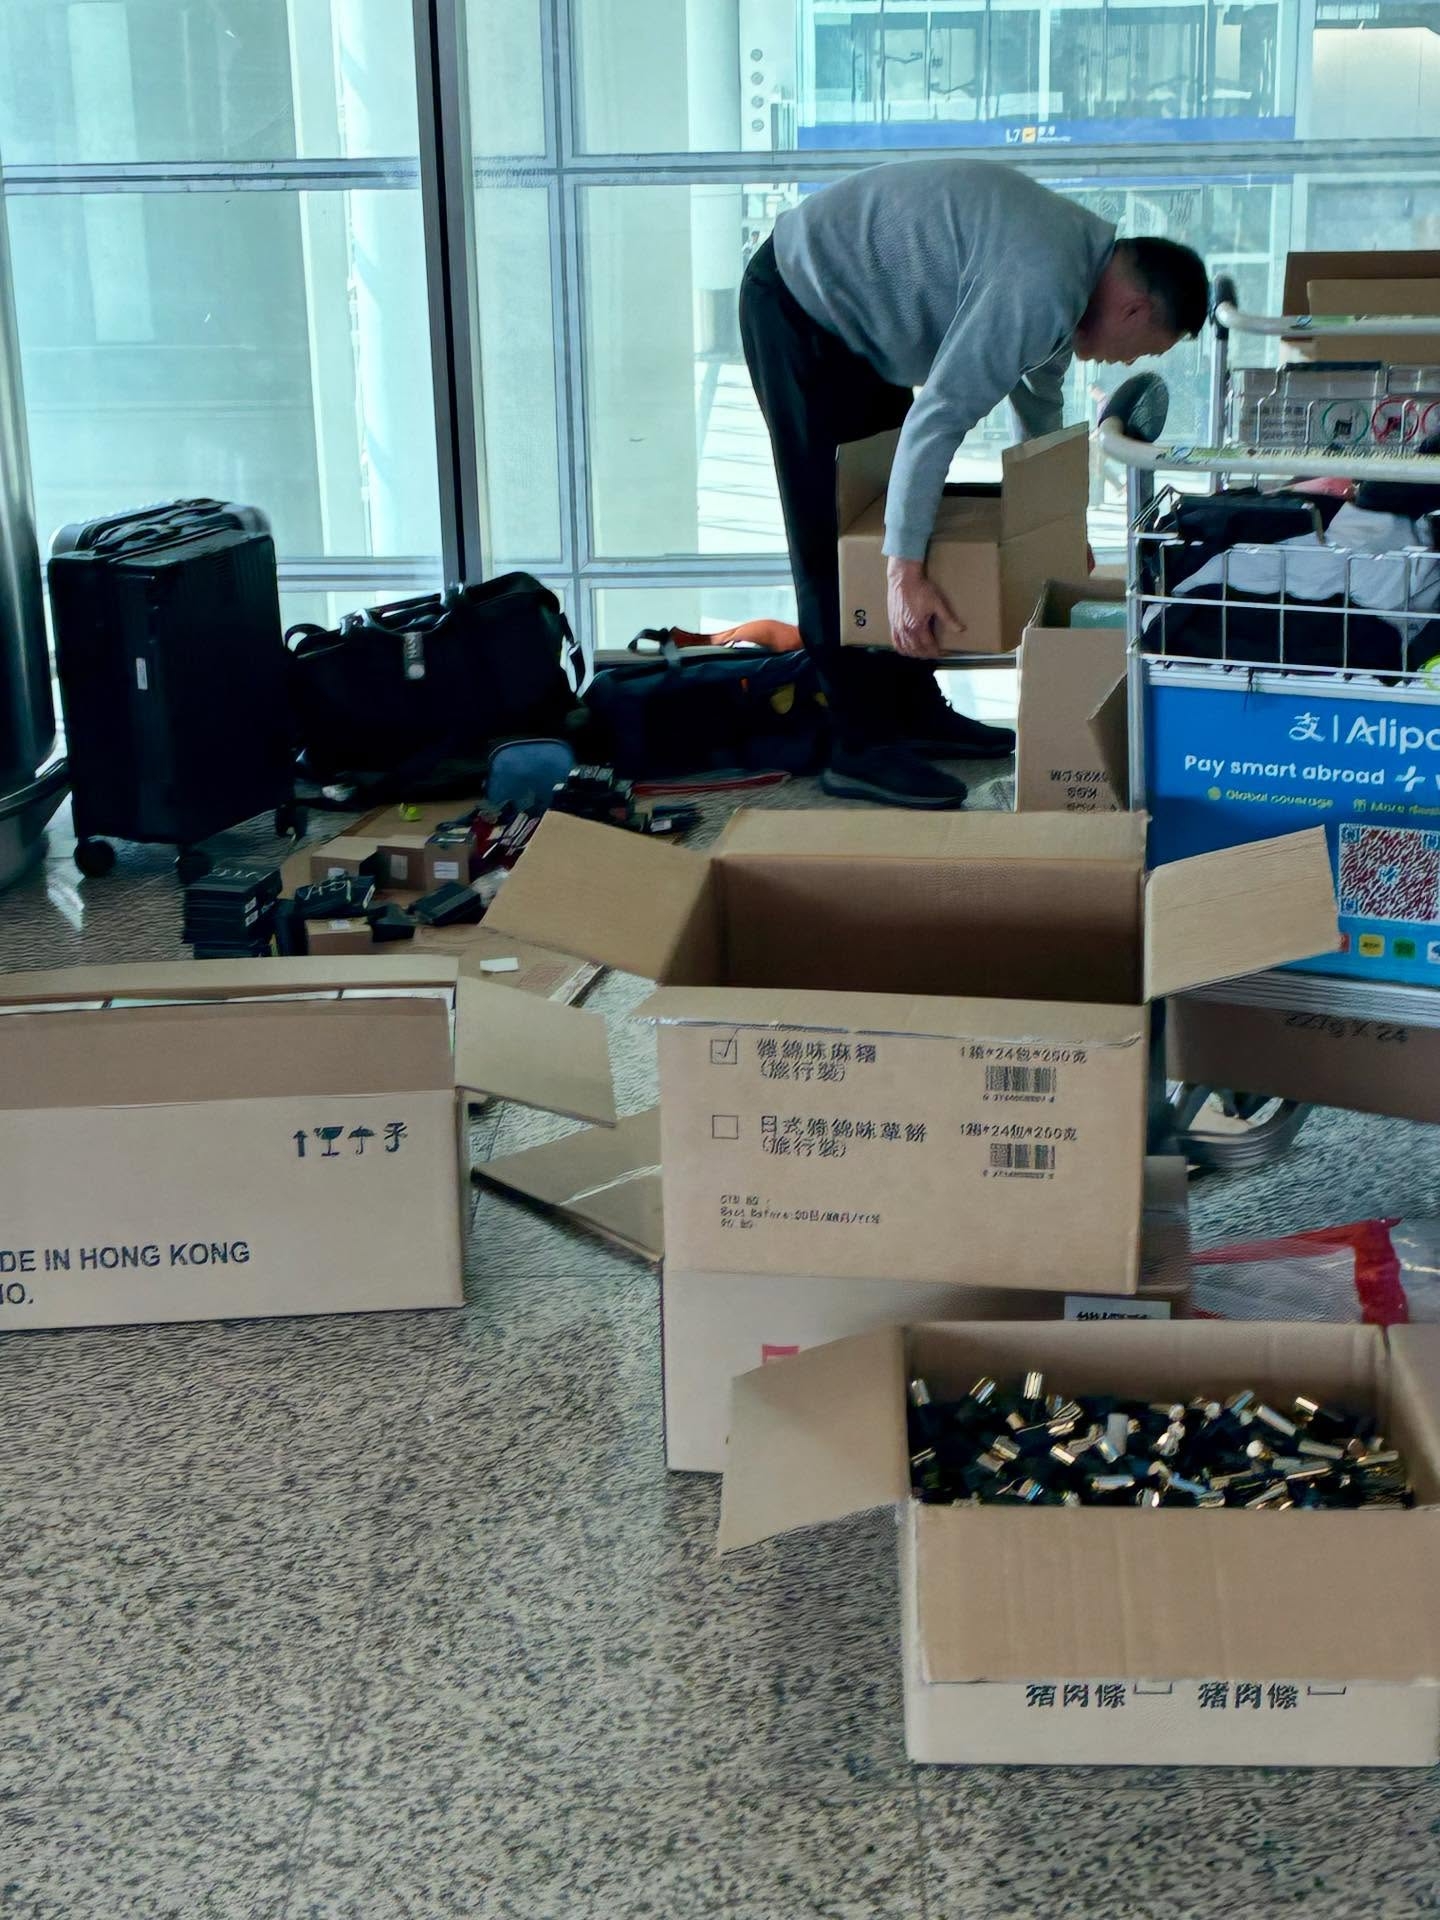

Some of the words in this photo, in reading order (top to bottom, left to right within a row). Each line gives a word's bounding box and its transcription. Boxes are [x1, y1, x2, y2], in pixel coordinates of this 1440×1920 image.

[1184, 754, 1225, 778] Pay
[1230, 760, 1297, 778] smart
[1302, 763, 1385, 785] abroad
[1225, 788, 1268, 801] Global
[1271, 794, 1335, 809] coverage
[0, 1250, 36, 1273] DE
[45, 1250, 71, 1271] IN
[80, 1245, 161, 1271] HONG
[169, 1241, 250, 1267] KONG
